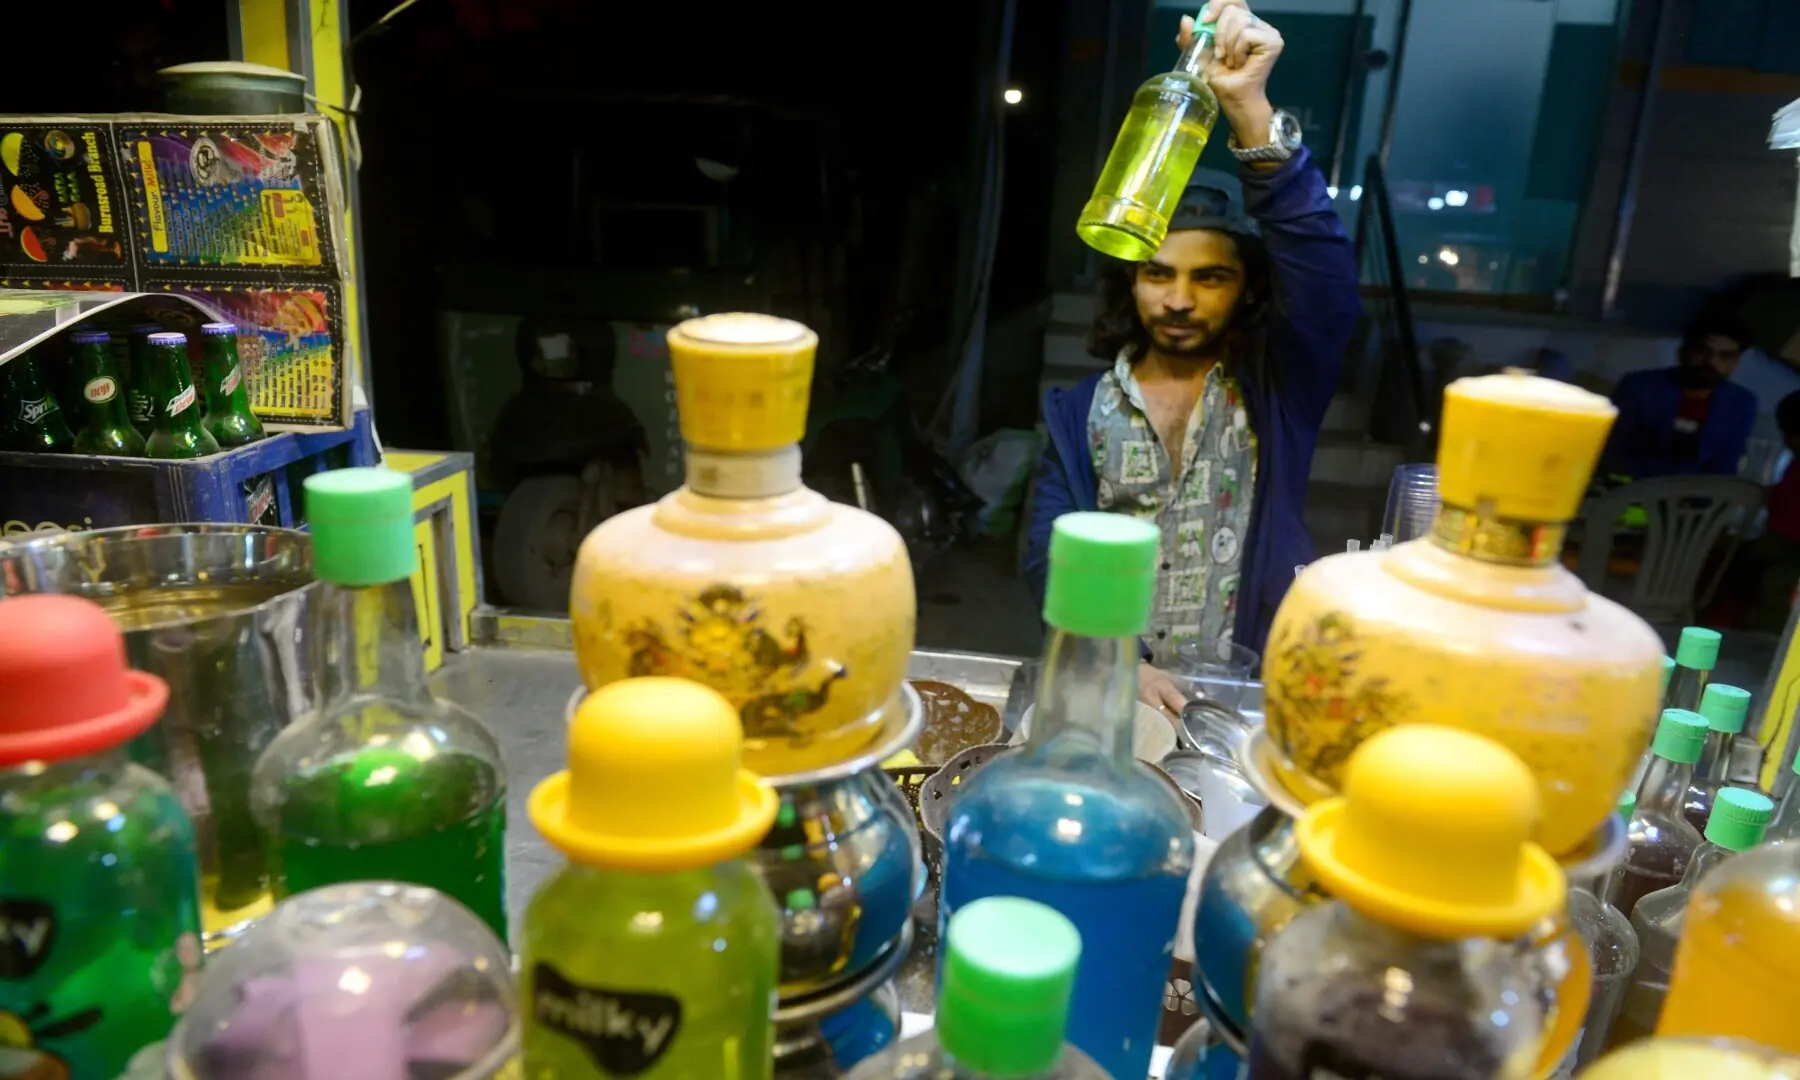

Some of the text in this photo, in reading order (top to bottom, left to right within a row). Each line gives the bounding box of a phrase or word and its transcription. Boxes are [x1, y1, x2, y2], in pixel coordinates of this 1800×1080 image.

[82, 132, 114, 233] Burnsroad Branch
[152, 191, 163, 232] Flavour
[23, 398, 51, 420] Spri
[538, 990, 674, 1057] milky
